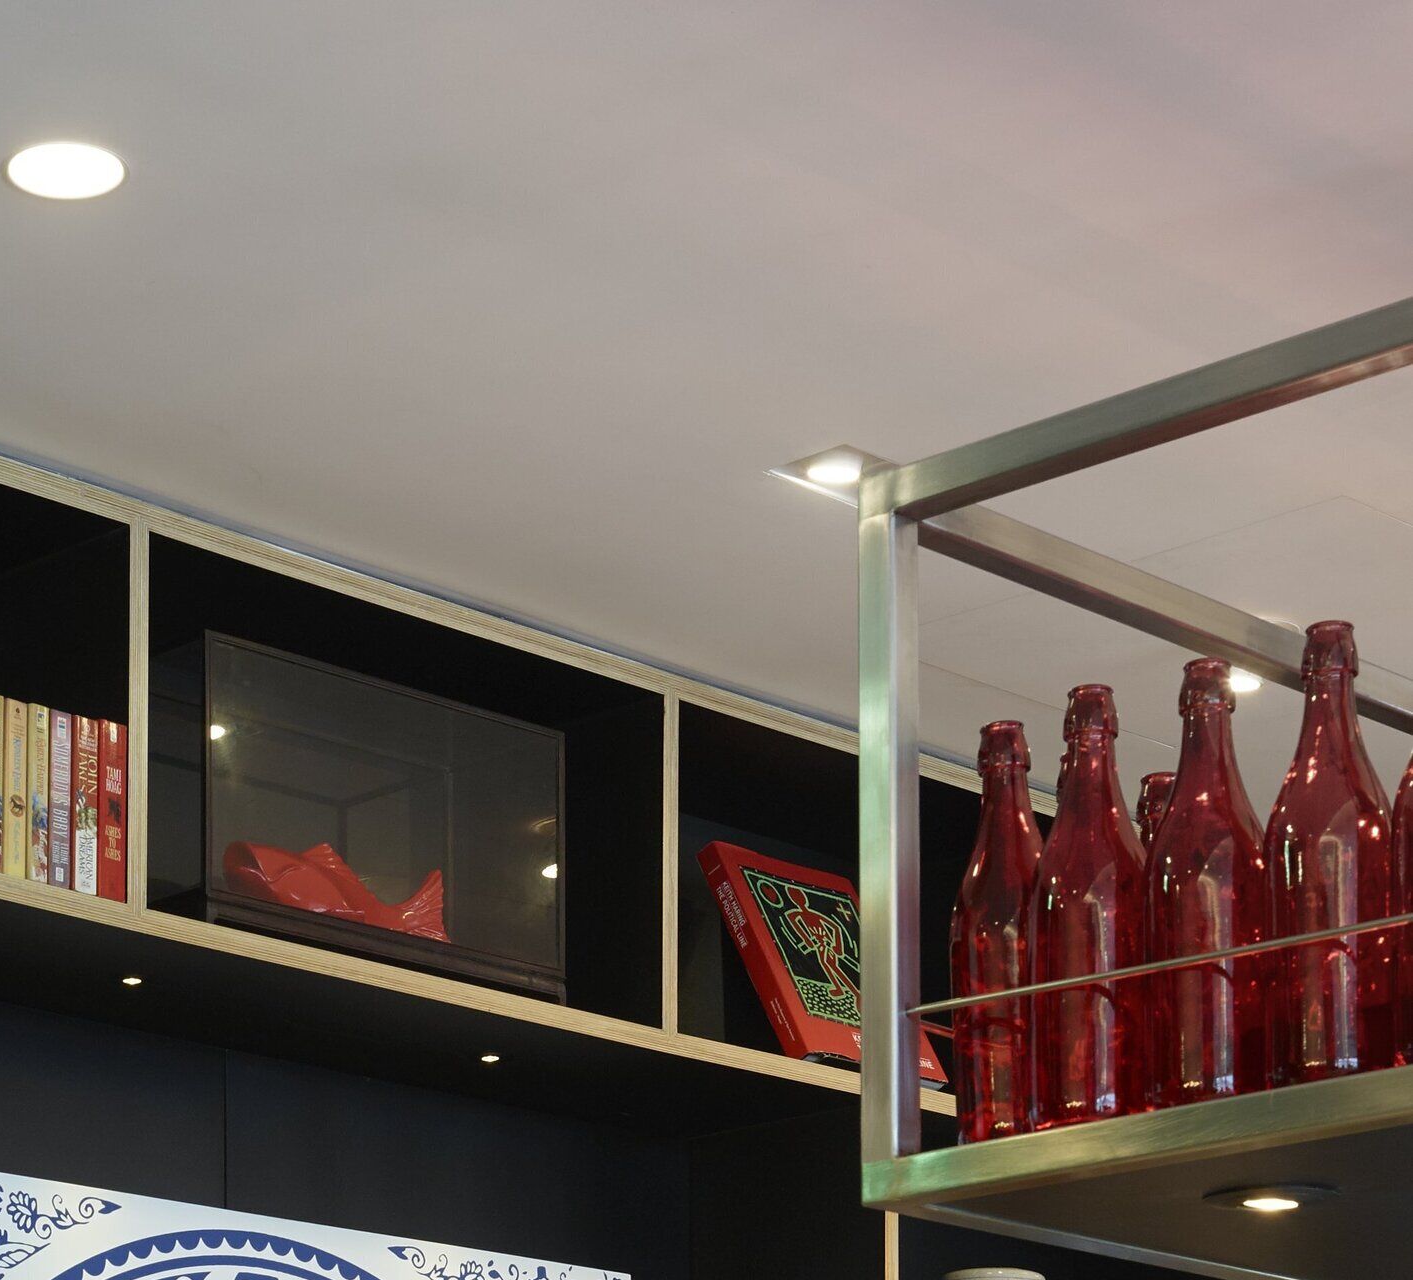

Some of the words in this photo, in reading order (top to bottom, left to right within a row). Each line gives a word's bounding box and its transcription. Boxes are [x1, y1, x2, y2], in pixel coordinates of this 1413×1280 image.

[87, 753, 98, 795] JOHN
[106, 765, 122, 781] TAMI
[106, 778, 122, 795] HOAG
[52, 808, 69, 838] BABY
[84, 834, 97, 881] AMERICAN
[716, 886, 727, 903] THE
[722, 900, 740, 934] POLITICAL
[736, 928, 748, 949] LINE
[722, 881, 737, 904] KEITH
[730, 898, 746, 927] HARING
